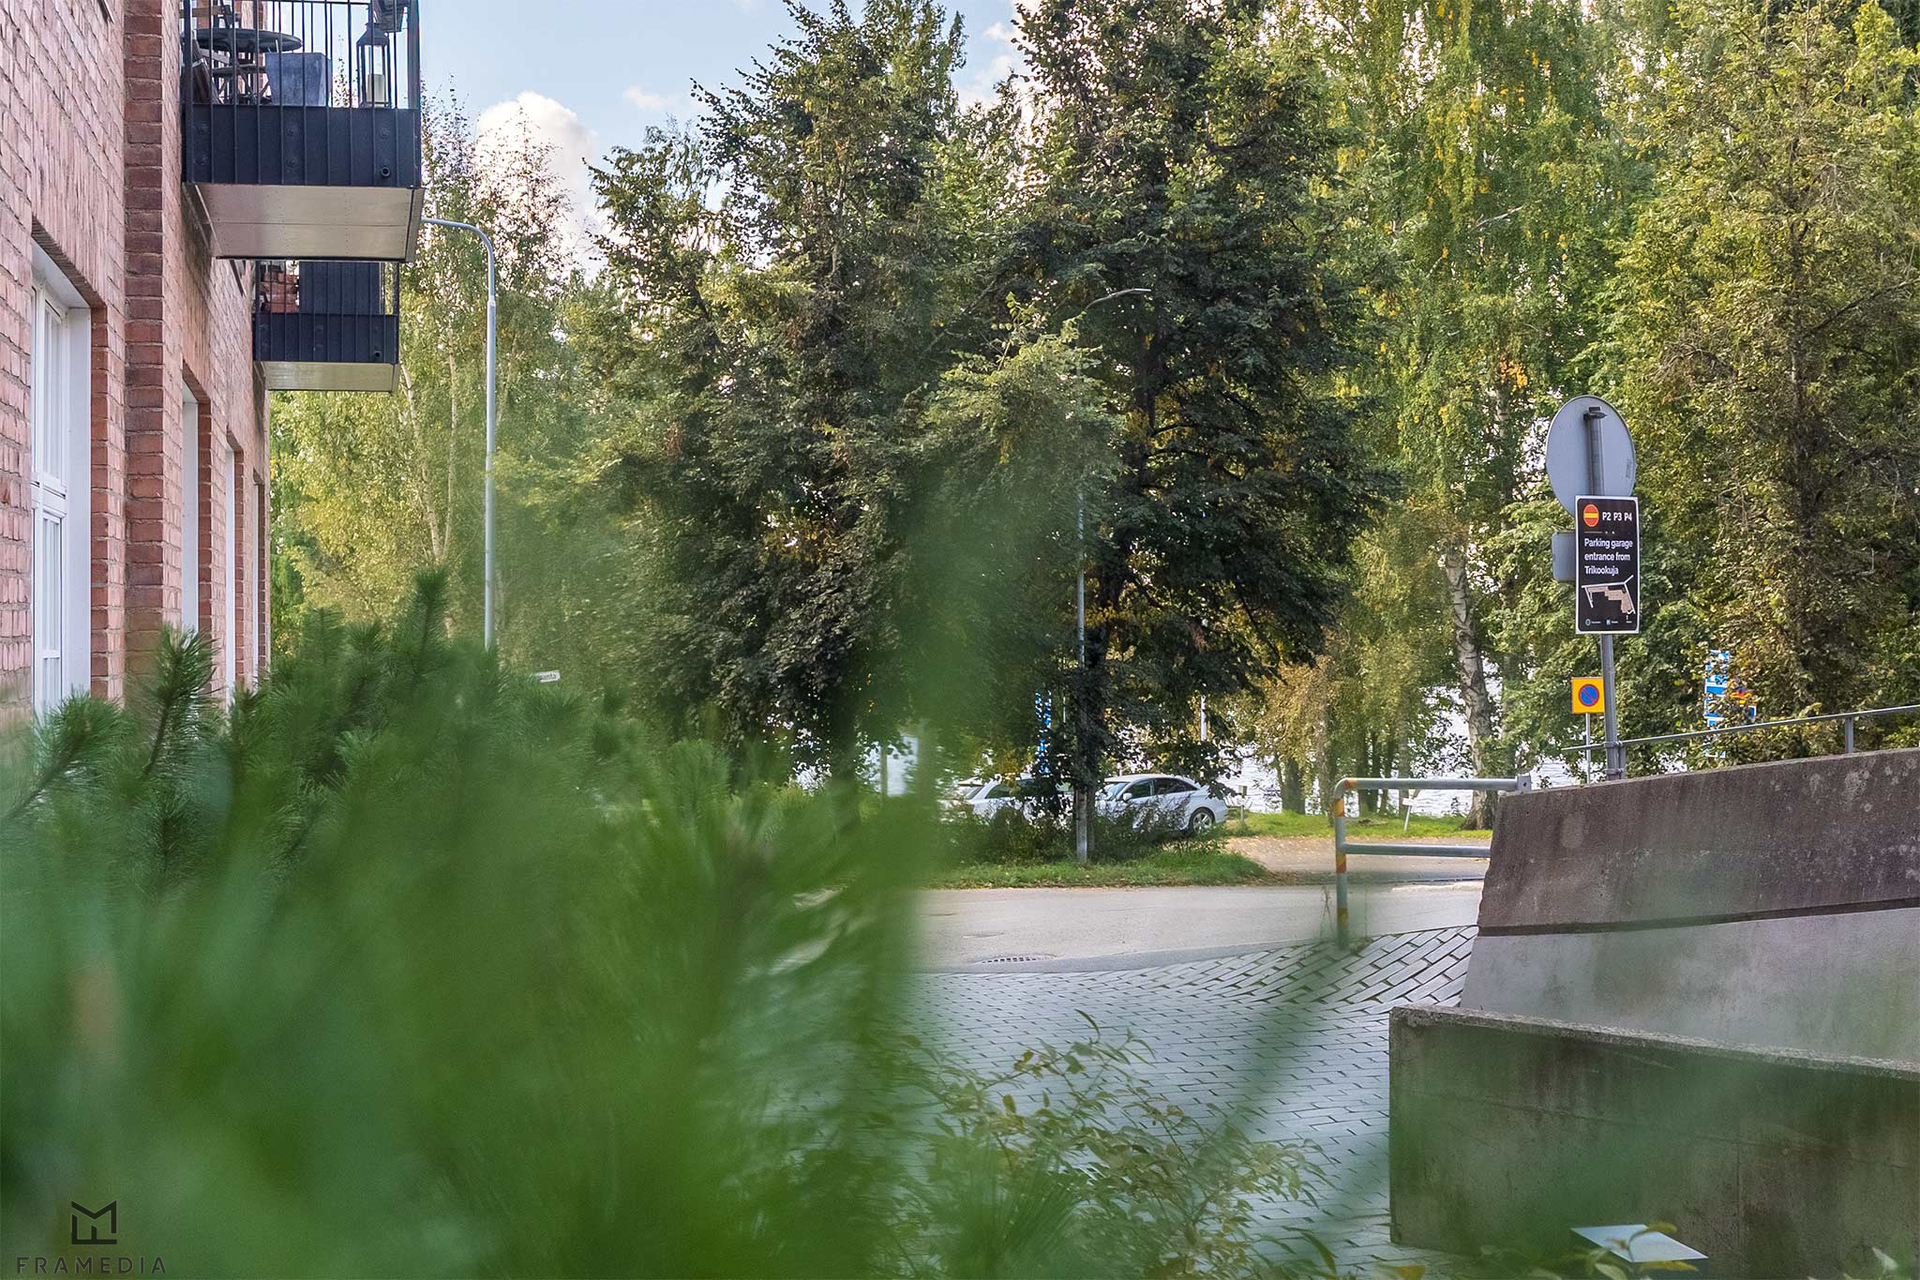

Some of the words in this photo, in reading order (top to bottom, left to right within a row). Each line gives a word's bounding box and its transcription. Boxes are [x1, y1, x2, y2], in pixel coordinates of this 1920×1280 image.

[1602, 512, 1611, 521] P2
[1613, 512, 1622, 521] P3
[1624, 513, 1632, 521] P4
[1584, 538, 1610, 549] Parking
[1611, 540, 1633, 549] garage
[1584, 552, 1614, 560] entrance
[1616, 553, 1630, 561] from
[1584, 566, 1619, 576] Trikookuja
